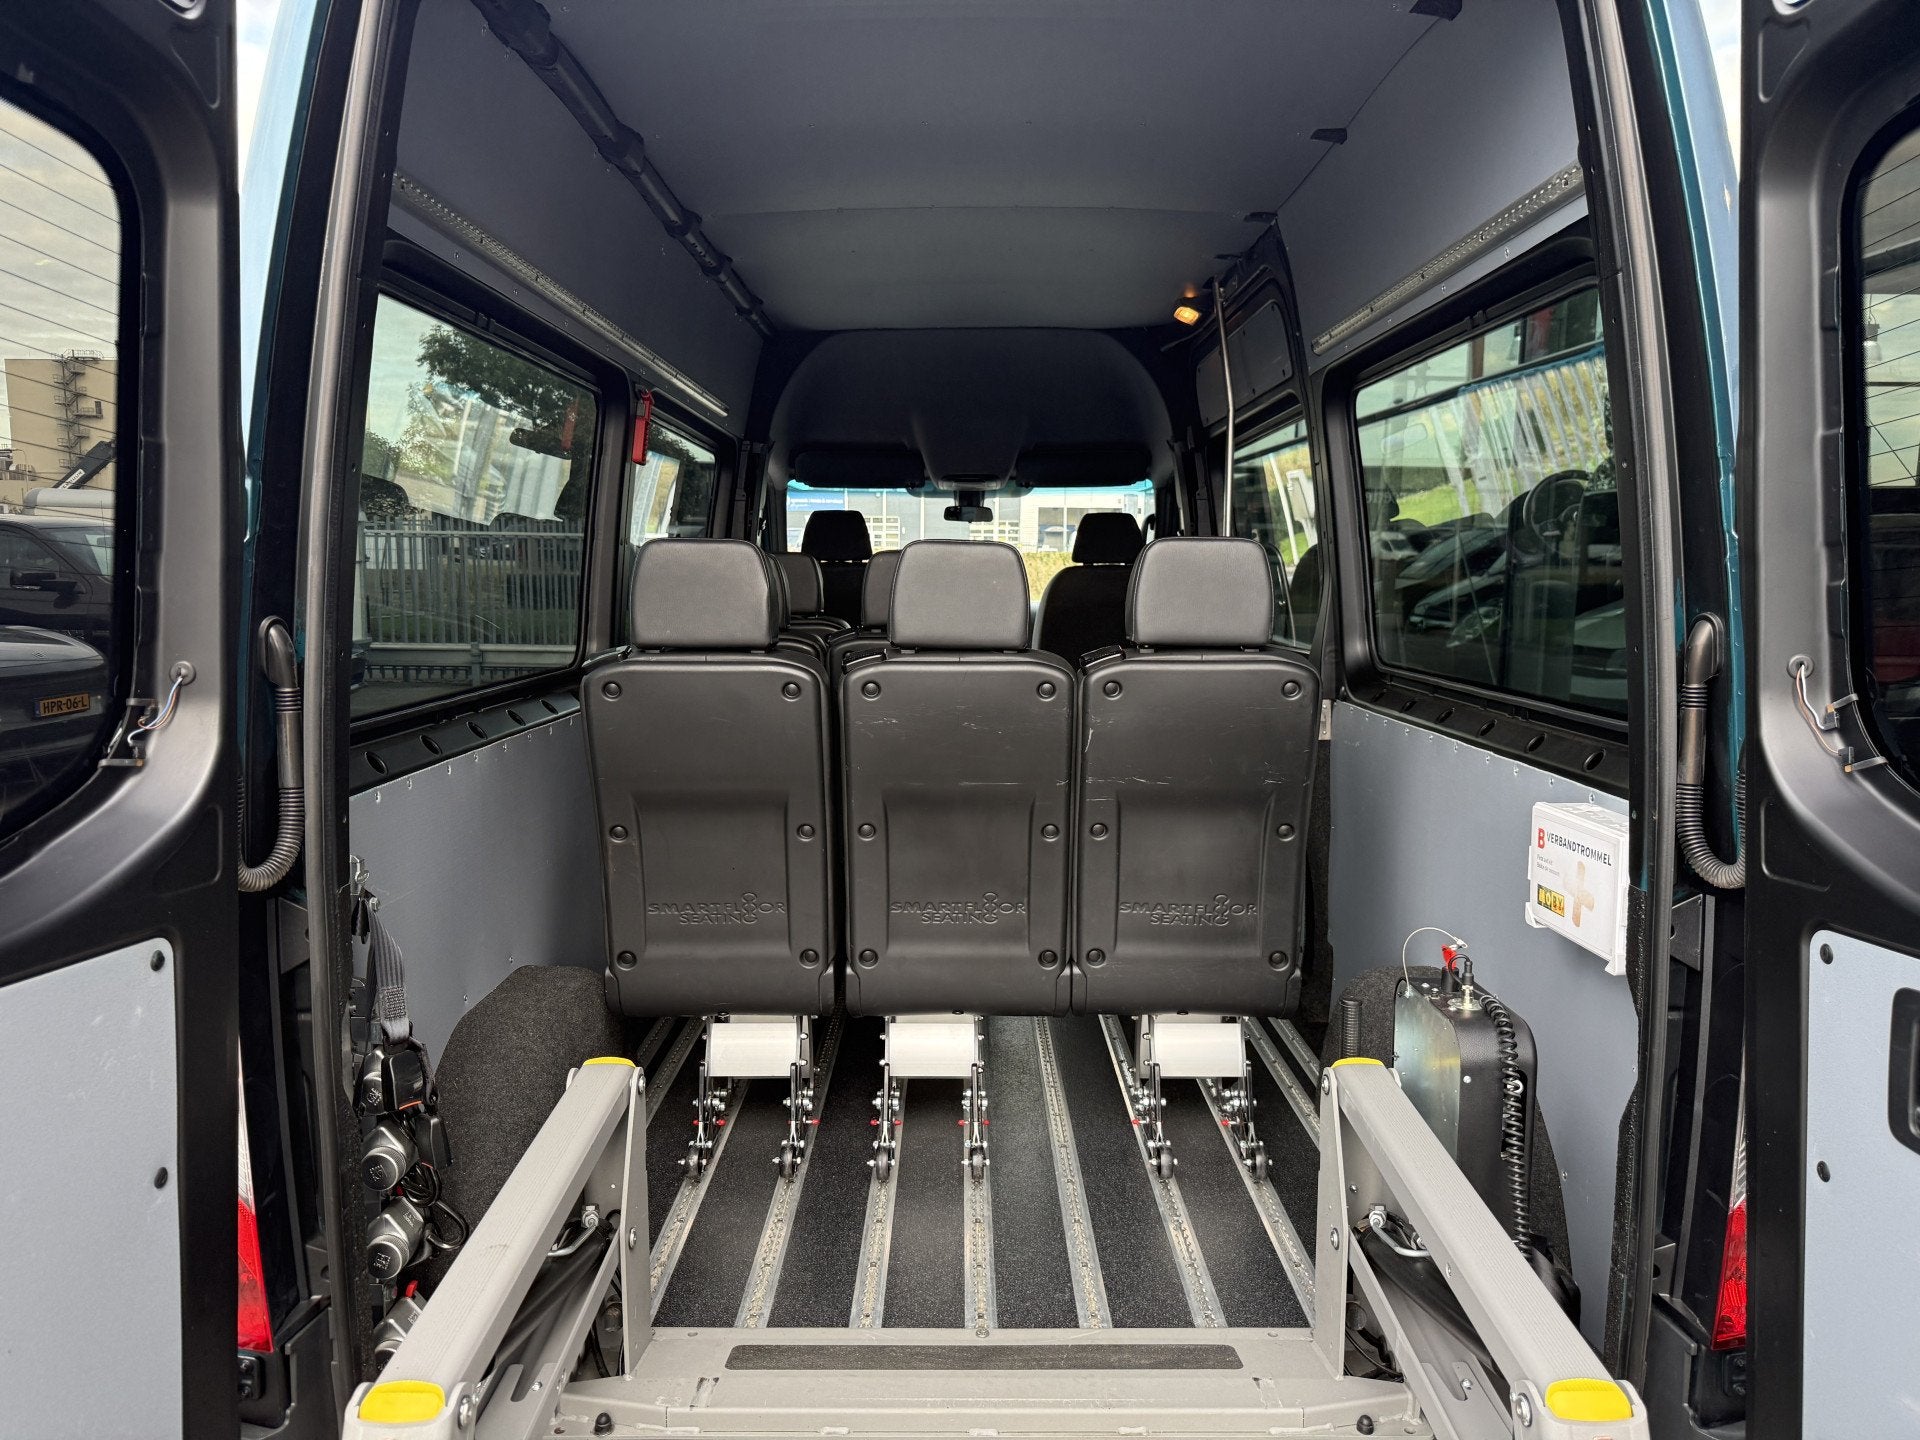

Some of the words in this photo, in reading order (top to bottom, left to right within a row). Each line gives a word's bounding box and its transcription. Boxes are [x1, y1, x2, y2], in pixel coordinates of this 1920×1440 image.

[42, 695, 87, 714] HPR-06-L
[1537, 827, 1546, 849] B
[1546, 831, 1612, 866] VERBANDTROMMEL
